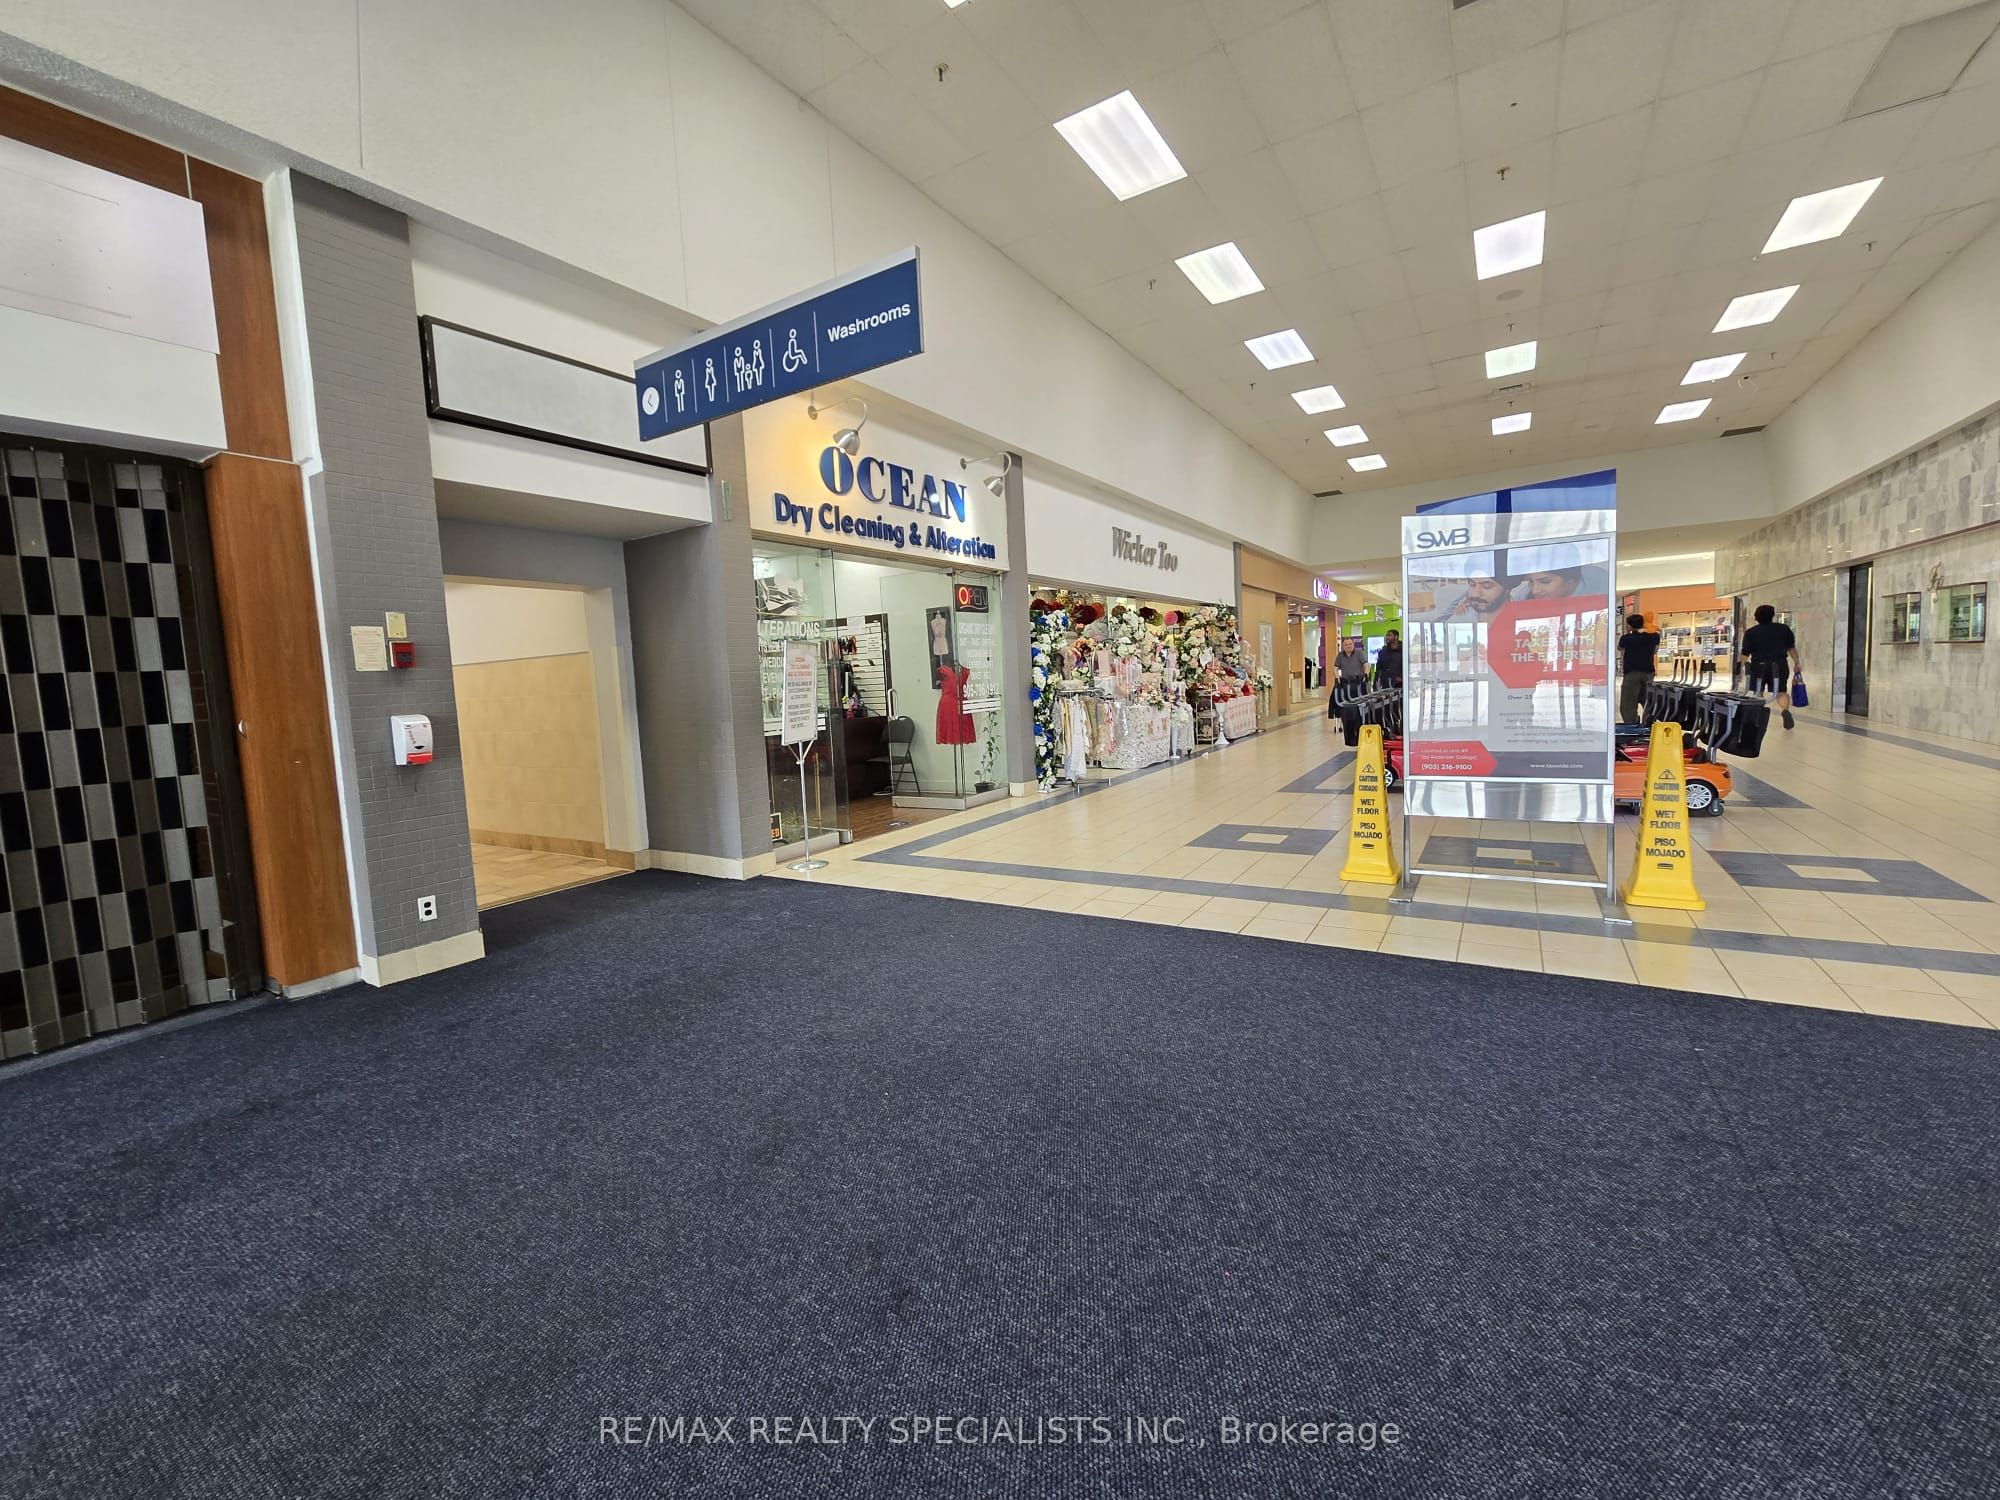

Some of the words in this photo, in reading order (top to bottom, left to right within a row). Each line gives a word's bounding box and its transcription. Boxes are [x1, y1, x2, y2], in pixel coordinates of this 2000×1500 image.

[827, 303, 911, 342] Washrooms
[819, 446, 967, 523] OCEAN
[774, 493, 813, 533] Dry
[818, 503, 905, 548] Cleaning
[909, 522, 922, 546] &
[925, 525, 996, 560] Alteration
[1416, 527, 1470, 549] SWB
[1111, 526, 1157, 566] Wicker
[1157, 540, 1178, 572] Too
[958, 586, 988, 606] OPEN
[1510, 652, 1534, 663] THE
[1359, 775, 1378, 783] CAUTION
[1653, 782, 1680, 791] CAUTION
[1360, 798, 1376, 806] WET
[1357, 807, 1379, 815] FLOOR
[1655, 810, 1676, 819] WET
[1360, 822, 1376, 830] PISO
[1650, 820, 1681, 830] FLOOR
[1354, 831, 1383, 840] MOJADO
[1654, 837, 1676, 846] PISO
[1645, 848, 1686, 858] MOJADO
